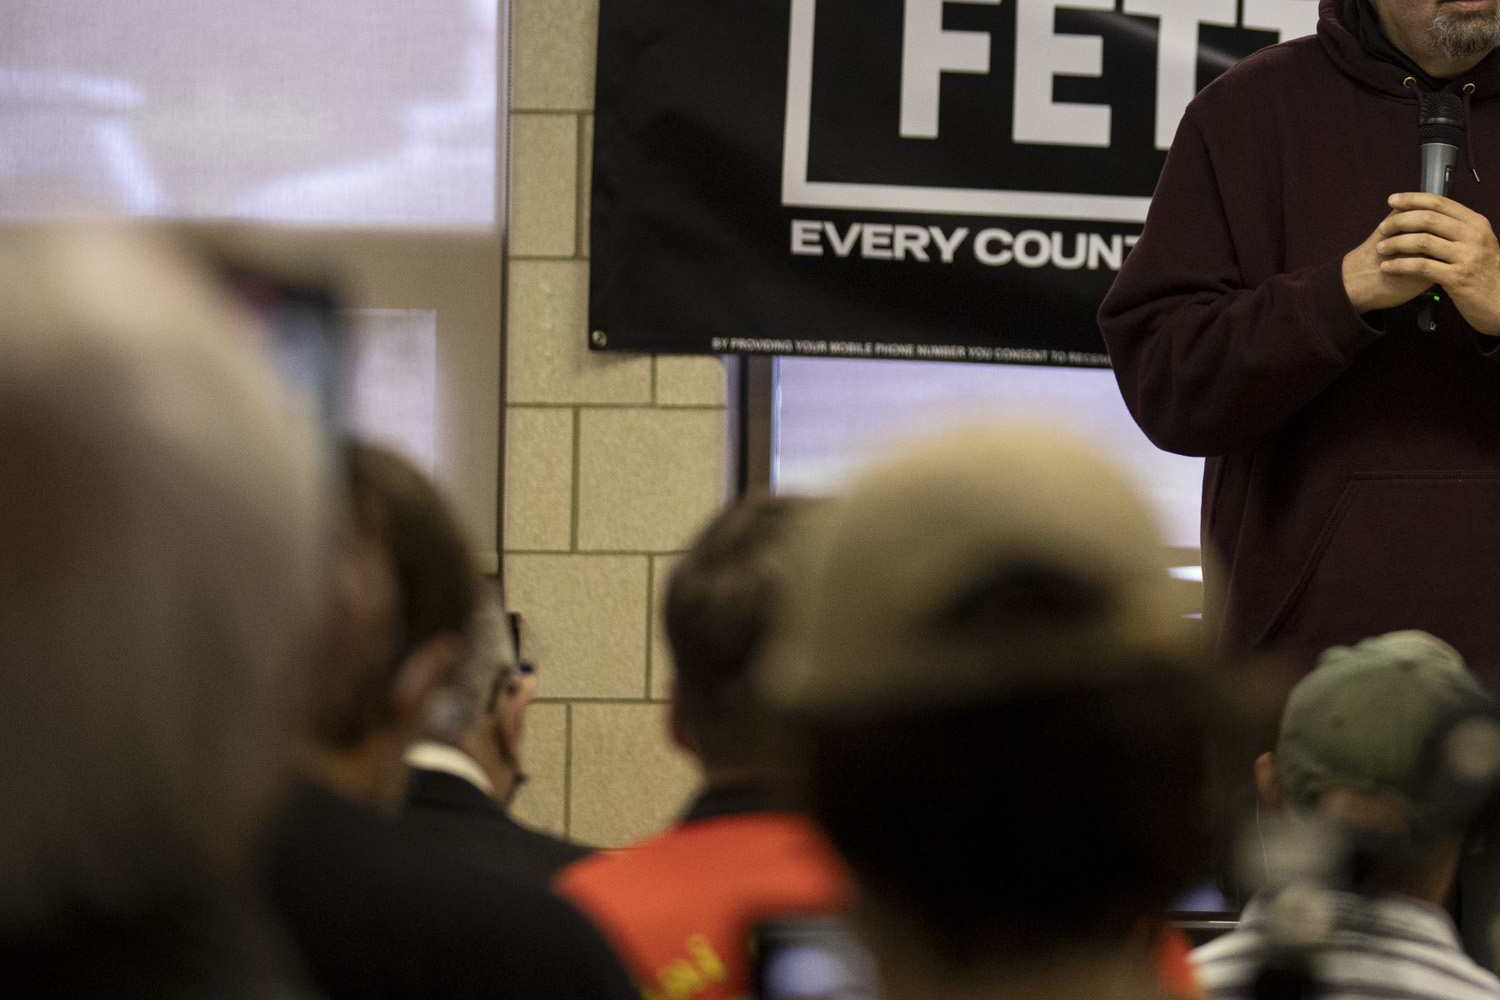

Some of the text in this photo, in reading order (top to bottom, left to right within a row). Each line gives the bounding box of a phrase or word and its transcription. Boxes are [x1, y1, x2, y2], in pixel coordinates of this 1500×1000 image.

[791, 219, 969, 264] EVERY
[973, 227, 1144, 272] COUN
[730, 338, 793, 352] PROVIDING
[829, 341, 872, 354] MOBILE
[874, 342, 914, 356] PHONE
